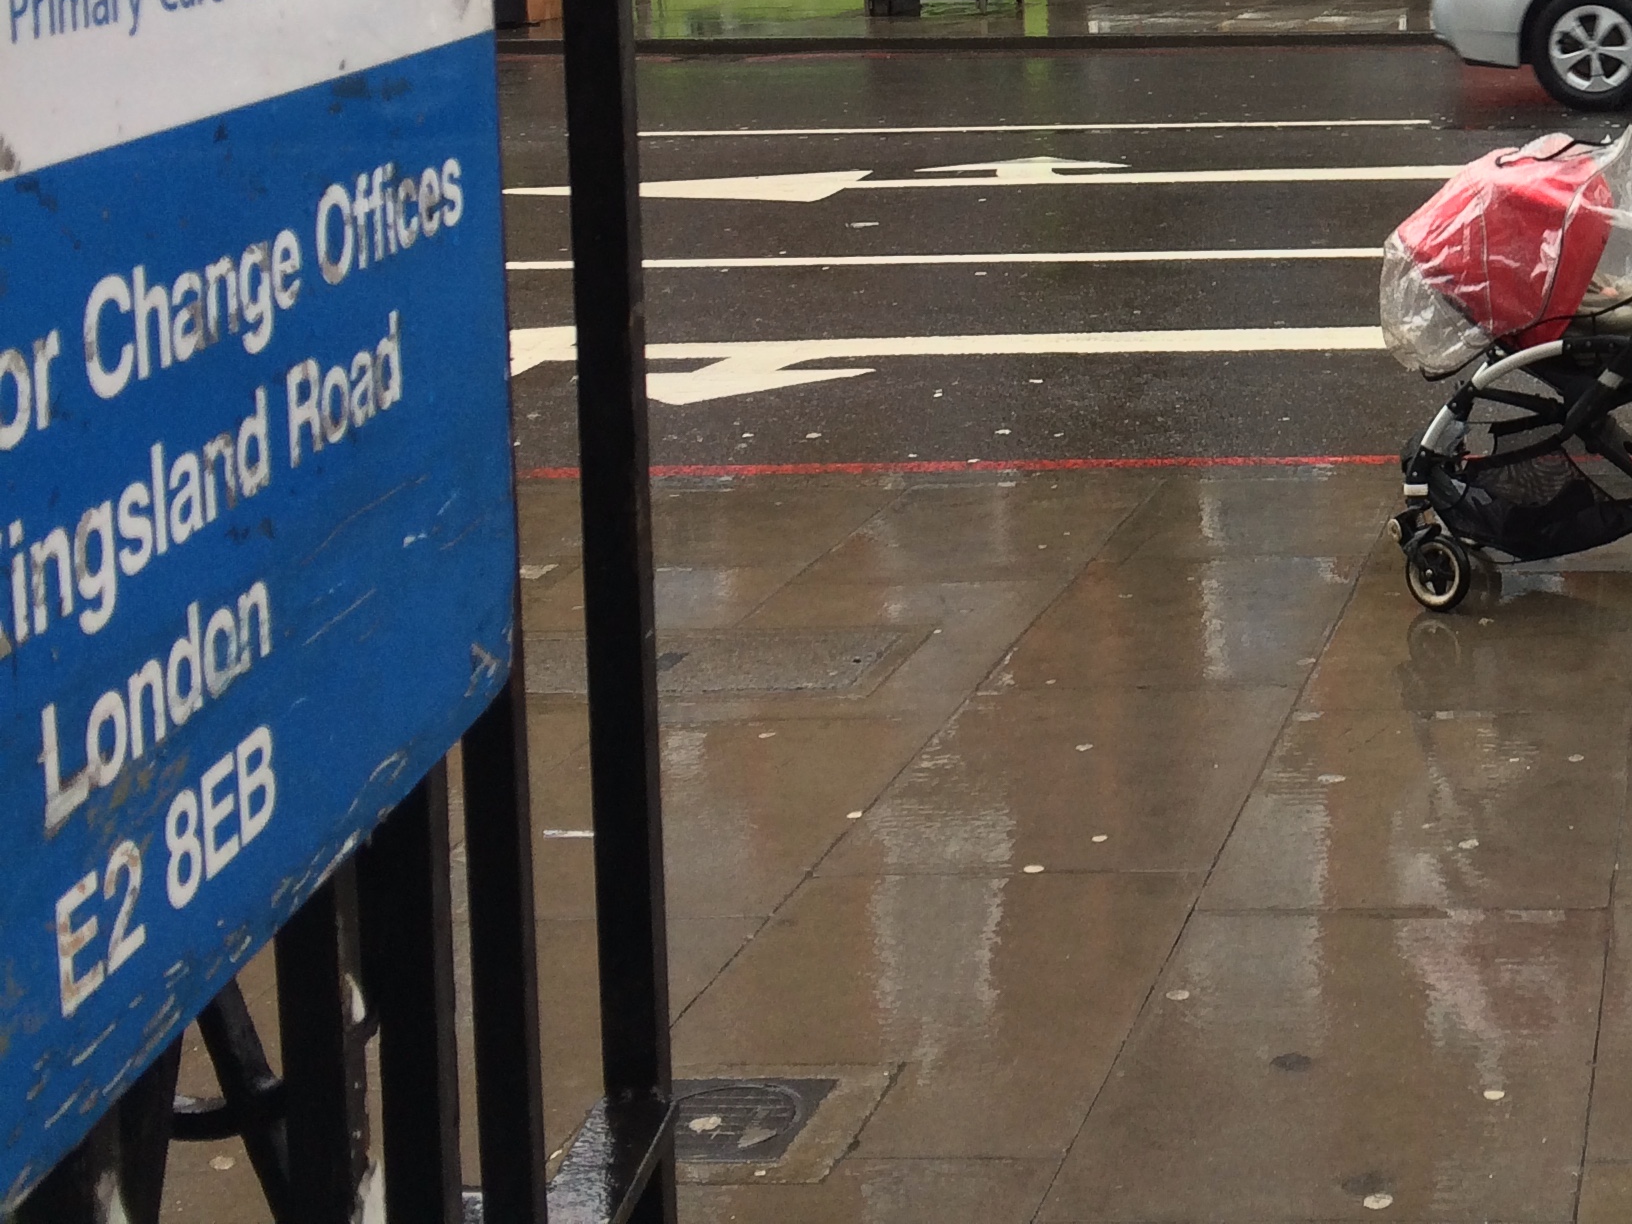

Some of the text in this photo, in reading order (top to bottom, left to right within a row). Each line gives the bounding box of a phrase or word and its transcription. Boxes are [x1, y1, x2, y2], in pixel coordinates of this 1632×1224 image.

[83, 227, 301, 400] Change
[315, 156, 464, 285] Offices
[0, 309, 403, 660] ingsland Road
[39, 578, 272, 832] London
[55, 725, 277, 1018] E2 8EB
